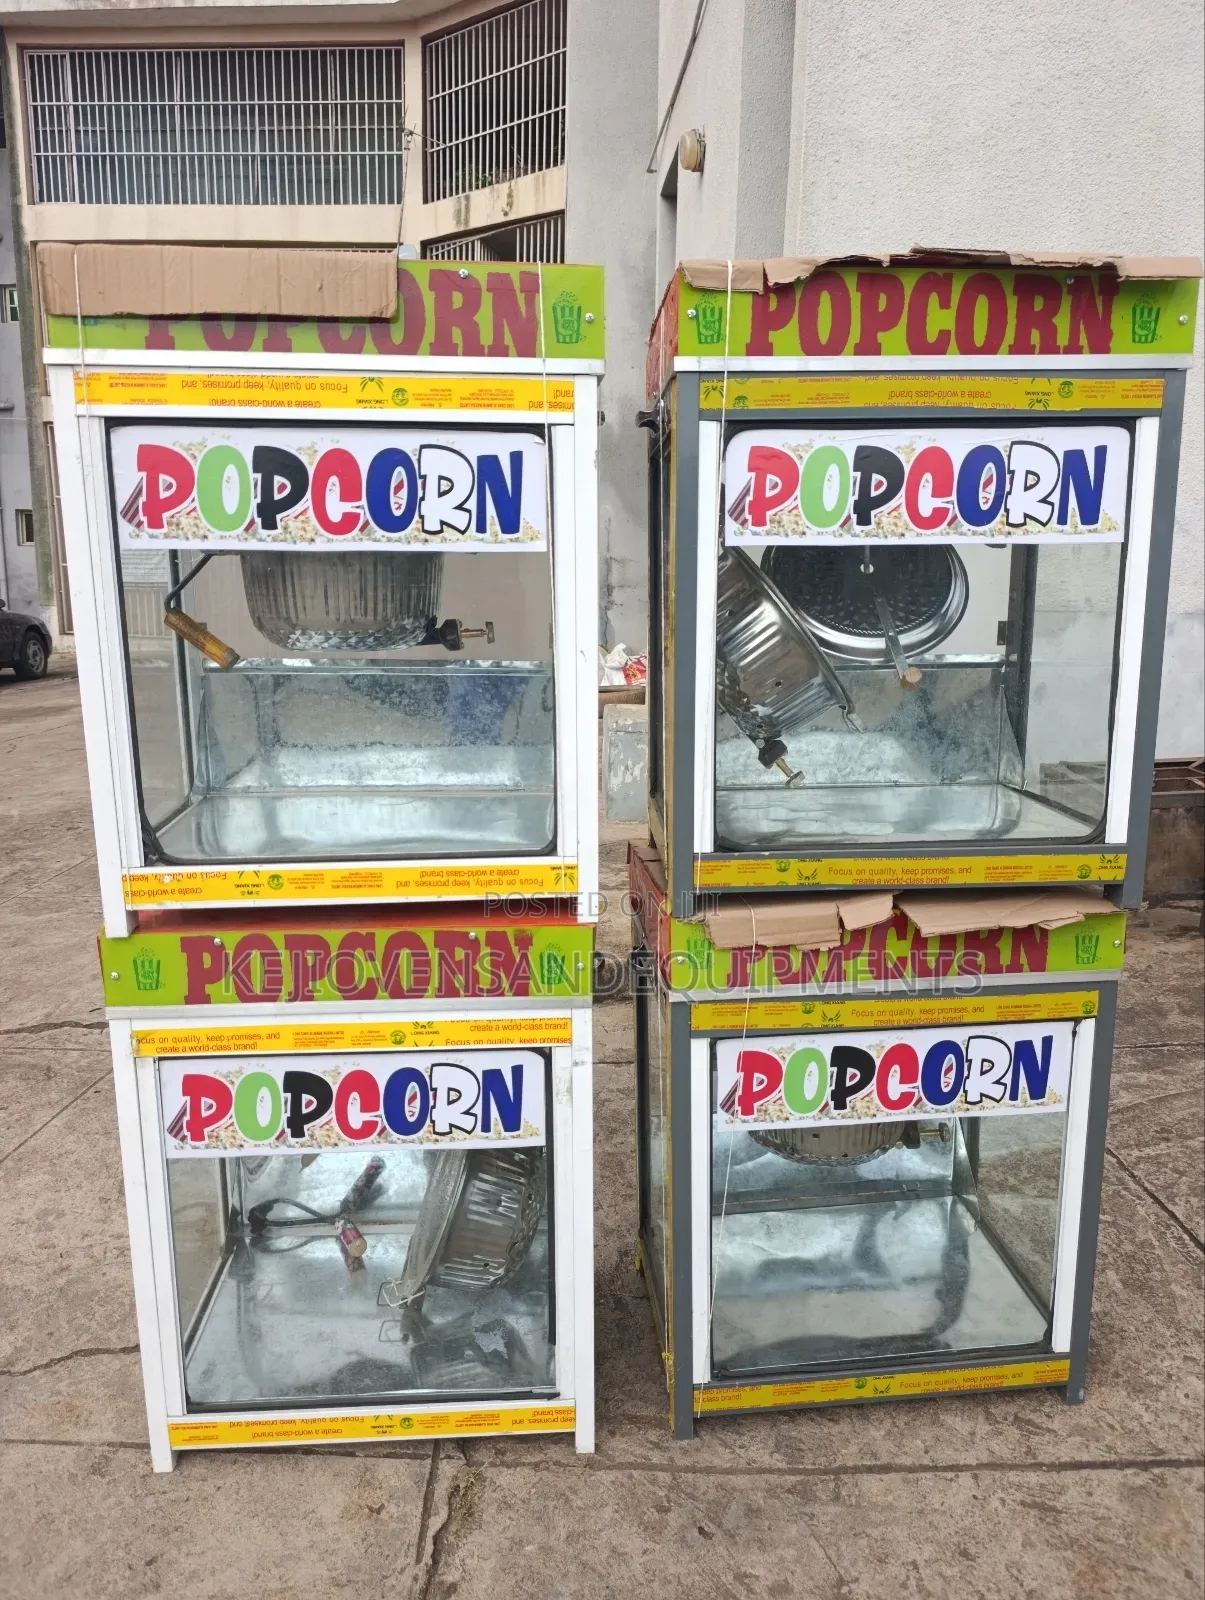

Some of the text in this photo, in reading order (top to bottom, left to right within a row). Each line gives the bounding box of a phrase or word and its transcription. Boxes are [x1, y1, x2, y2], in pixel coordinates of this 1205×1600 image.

[746, 270, 1119, 355] POPCORN
[182, 380, 198, 388] and
[200, 379, 240, 389] promises,
[242, 380, 264, 390] keep
[268, 380, 301, 390] quality,
[319, 382, 348, 392] Focus
[889, 391, 912, 399] brand!
[915, 391, 958, 399] world-class
[528, 401, 543, 410] and
[136, 443, 524, 536] POPCORN
[747, 440, 1108, 531] POPCORN
[420, 870, 443, 878] brand!
[446, 870, 488, 878] world-class
[829, 866, 853, 875] Focus
[869, 867, 898, 877] quality,
[902, 868, 919, 876] keep
[921, 866, 956, 876] promises,
[396, 880, 410, 888] and
[413, 878, 450, 888] promises,
[451, 878, 470, 888] keep
[474, 877, 503, 886] quality,
[520, 878, 544, 886] Focus
[884, 876, 926, 884] world-class
[926, 875, 949, 884] brand!
[178, 887, 202, 895] create
[180, 929, 534, 1005] POPCORN
[920, 1006, 935, 1015] keep
[938, 1005, 969, 1014] promises,
[903, 1017, 941, 1025] world-class
[943, 1015, 964, 1024] brand!
[470, 1024, 493, 1032] create
[502, 1022, 543, 1031] world-class
[545, 1022, 568, 1030] brand!
[172, 1035, 203, 1044] quality,
[206, 1034, 224, 1042] keep
[226, 1033, 264, 1042] promises,
[189, 1043, 232, 1052] world-class
[234, 1042, 258, 1051] brand!
[736, 1035, 1054, 1116] POPCORN
[182, 1062, 524, 1142] POPCORN
[935, 1378, 960, 1386] quality,
[963, 1376, 978, 1385] keep
[980, 1374, 1009, 1383] promises,
